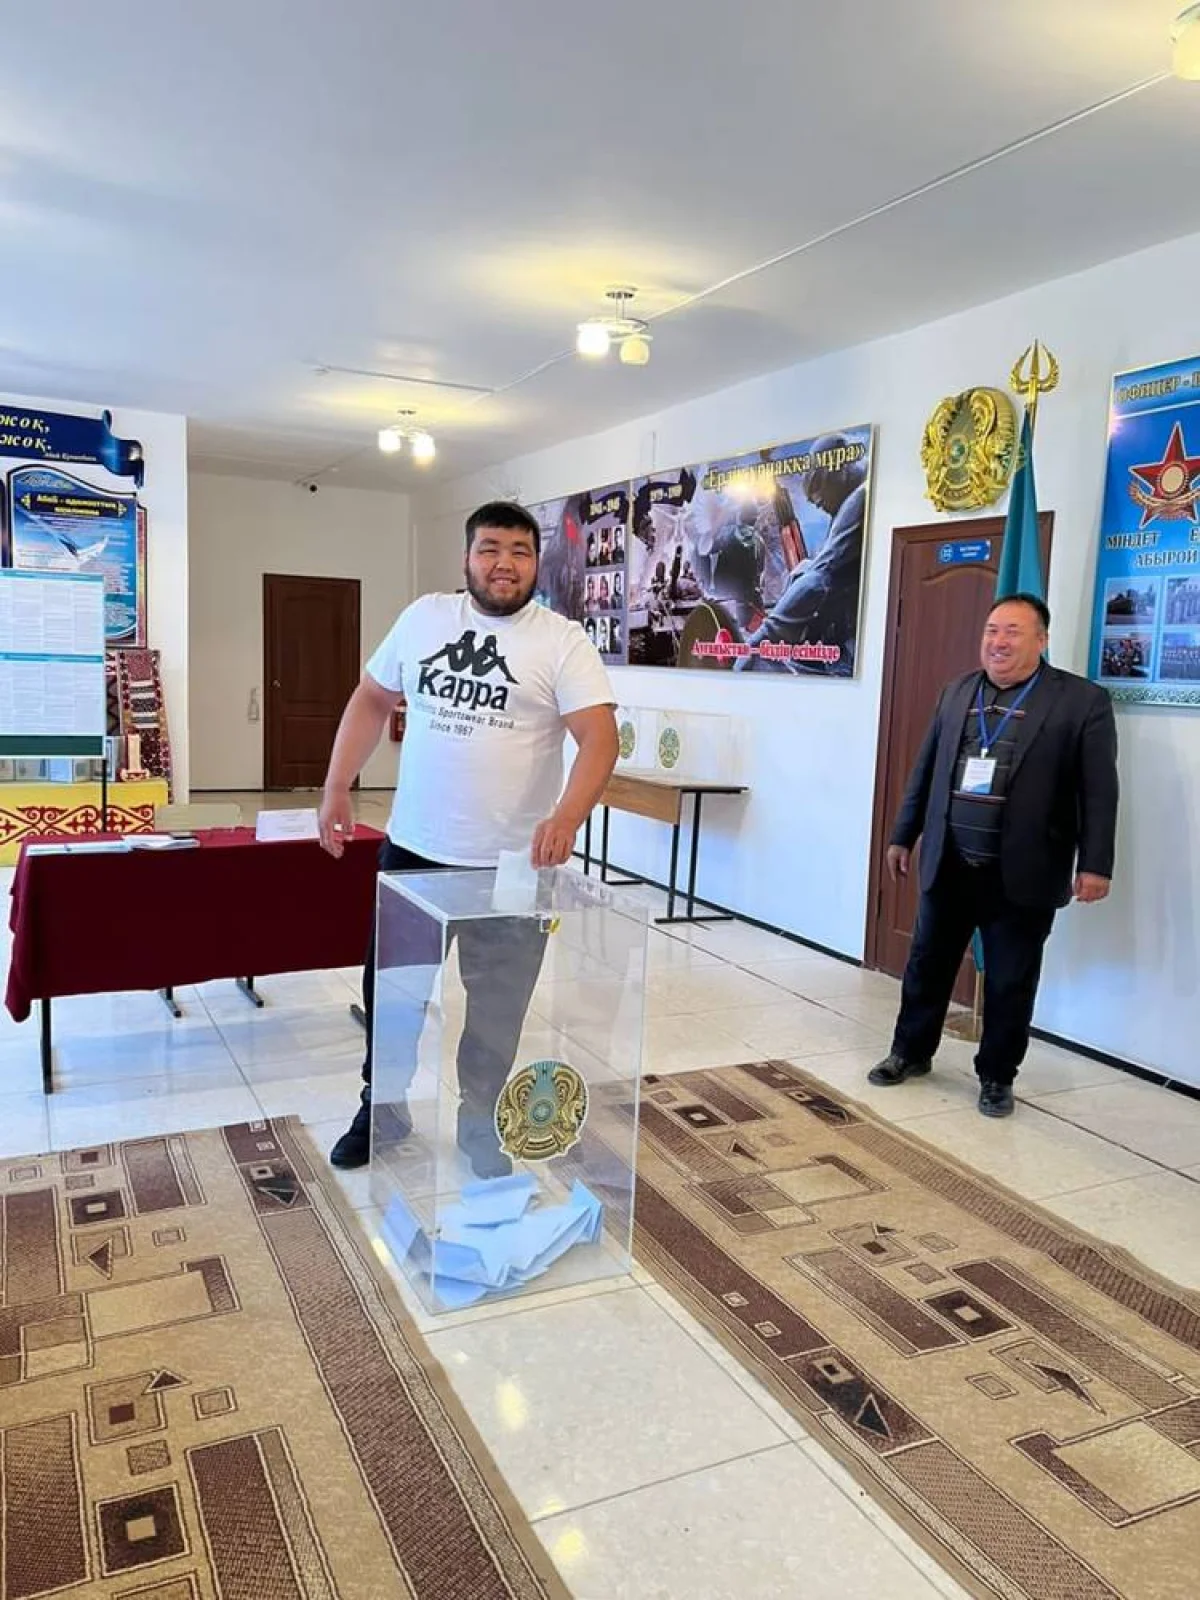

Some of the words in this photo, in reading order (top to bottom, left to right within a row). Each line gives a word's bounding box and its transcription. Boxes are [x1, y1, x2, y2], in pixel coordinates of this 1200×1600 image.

[1106, 530, 1161, 549] МІНДЕТ
[1136, 548, 1198, 567] АБЫРОЙ
[417, 666, 508, 711] Kappa
[430, 719, 451, 732] Since
[438, 707, 486, 724] Sportswear
[488, 716, 515, 729] Brand
